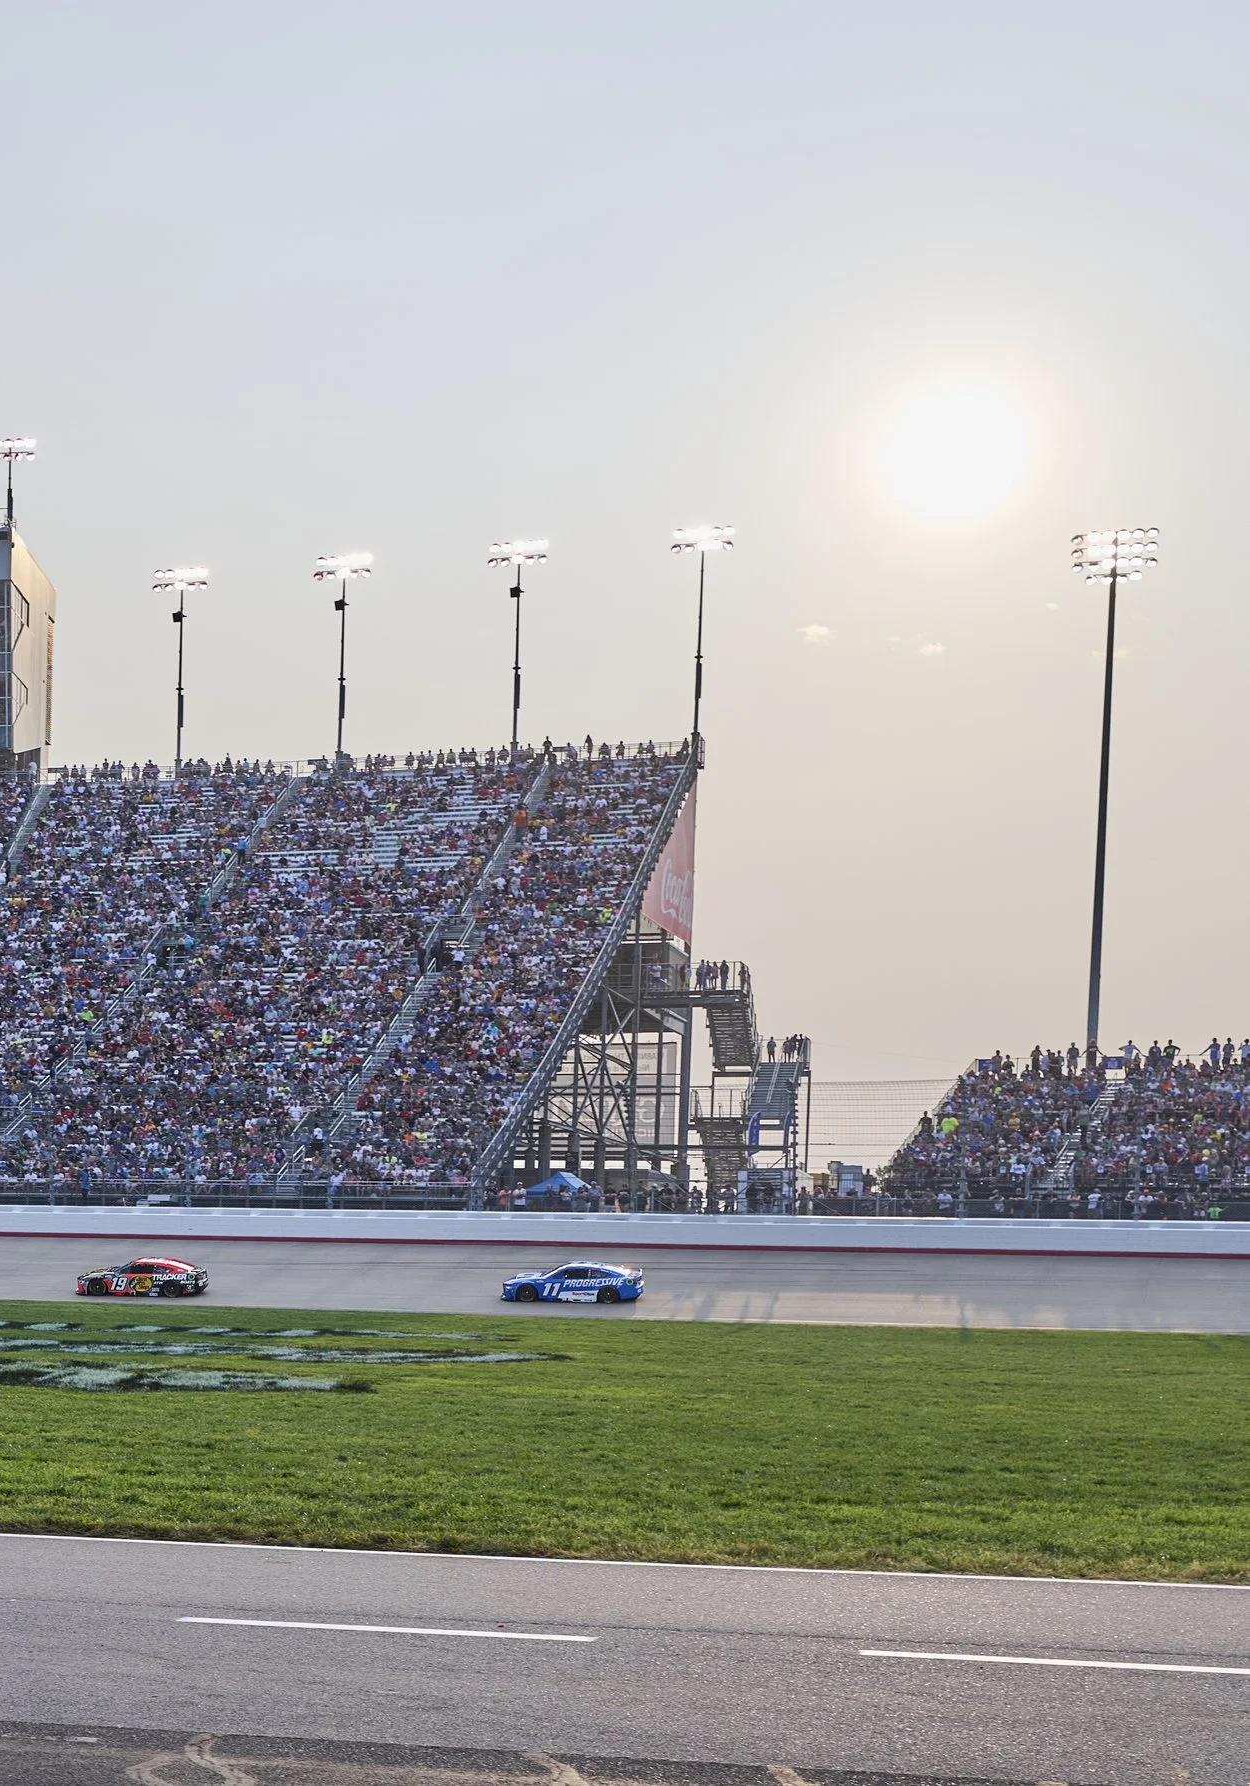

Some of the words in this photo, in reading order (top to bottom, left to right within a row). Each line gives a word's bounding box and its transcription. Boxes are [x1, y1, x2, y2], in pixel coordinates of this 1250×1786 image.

[152, 1273, 187, 1281] TRACKER
[563, 1278, 624, 1288] PROGRESSIVE
[110, 1277, 128, 1291] 19
[542, 1282, 561, 1297] 11
